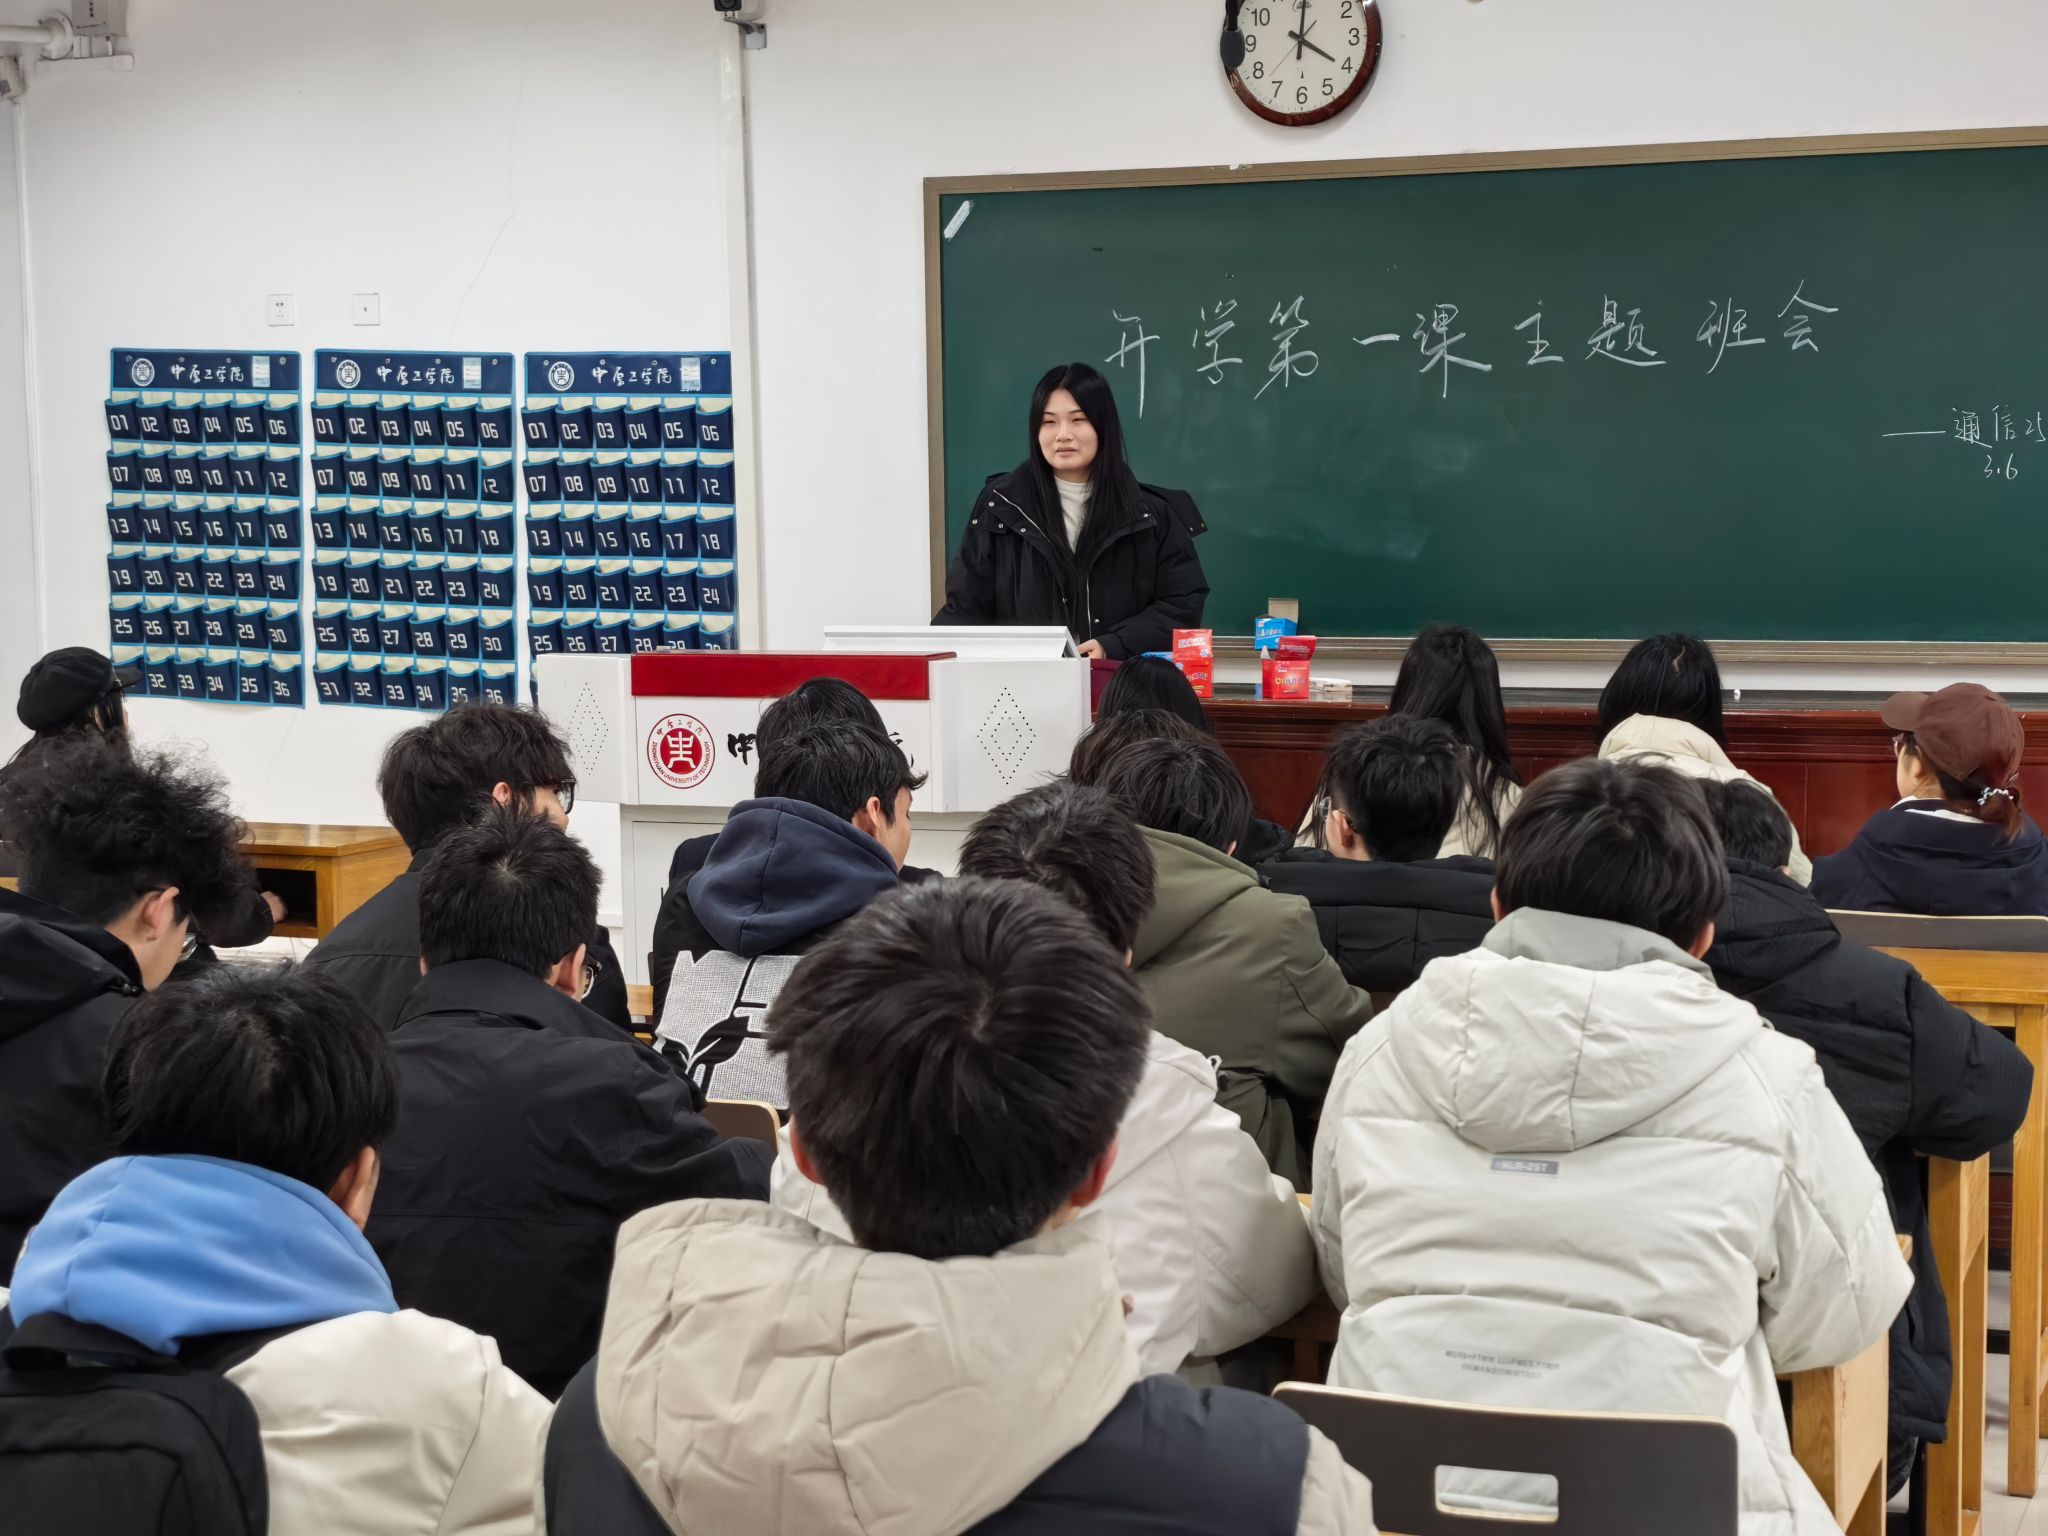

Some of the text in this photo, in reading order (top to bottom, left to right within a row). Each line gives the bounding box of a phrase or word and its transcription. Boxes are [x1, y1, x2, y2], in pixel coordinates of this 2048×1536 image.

[1251, 8, 1270, 27] 10
[1341, 0, 1352, 18] 2
[1245, 34, 1257, 52] 9
[1348, 28, 1360, 46] 3
[1252, 61, 1264, 79] 8
[1341, 57, 1353, 74] 4
[1271, 80, 1283, 98] 7
[1296, 86, 1308, 104] 6
[1322, 78, 1333, 96] 5
[111, 415, 287, 436] 01 02 03 04 05 06
[316, 418, 499, 439] 01 02 03 04 05 06
[528, 422, 720, 442] 01 02 03 04 05 06
[1984, 453, 2018, 480] 3.6
[113, 467, 289, 489] 07 08 09 10 11 12
[317, 469, 499, 494] 07 08 09 10 11 12
[529, 476, 721, 496] 07 08 09 10 11 12
[111, 519, 288, 539] 13 14 15 16 17 18
[315, 523, 500, 546] 13 14 15 16 17 18
[532, 530, 721, 550] 13 14 15 16 17 18
[113, 570, 286, 591] 19 20 21 22 23 24
[319, 576, 500, 600] 19 20 21 22 23 24
[534, 585, 720, 605] 19 20 21 22 23 24
[114, 619, 288, 644] 25 26 27 28 29 30
[318, 627, 503, 652] 25 26 27 28 29 30
[534, 635, 553, 652] 25
[567, 636, 587, 652] 26
[600, 636, 617, 653] 27
[149, 674, 291, 697] 32 33 34 35 36
[320, 682, 340, 696] 31
[354, 682, 373, 697] 32
[386, 685, 405, 701] 33
[416, 686, 433, 702] 34
